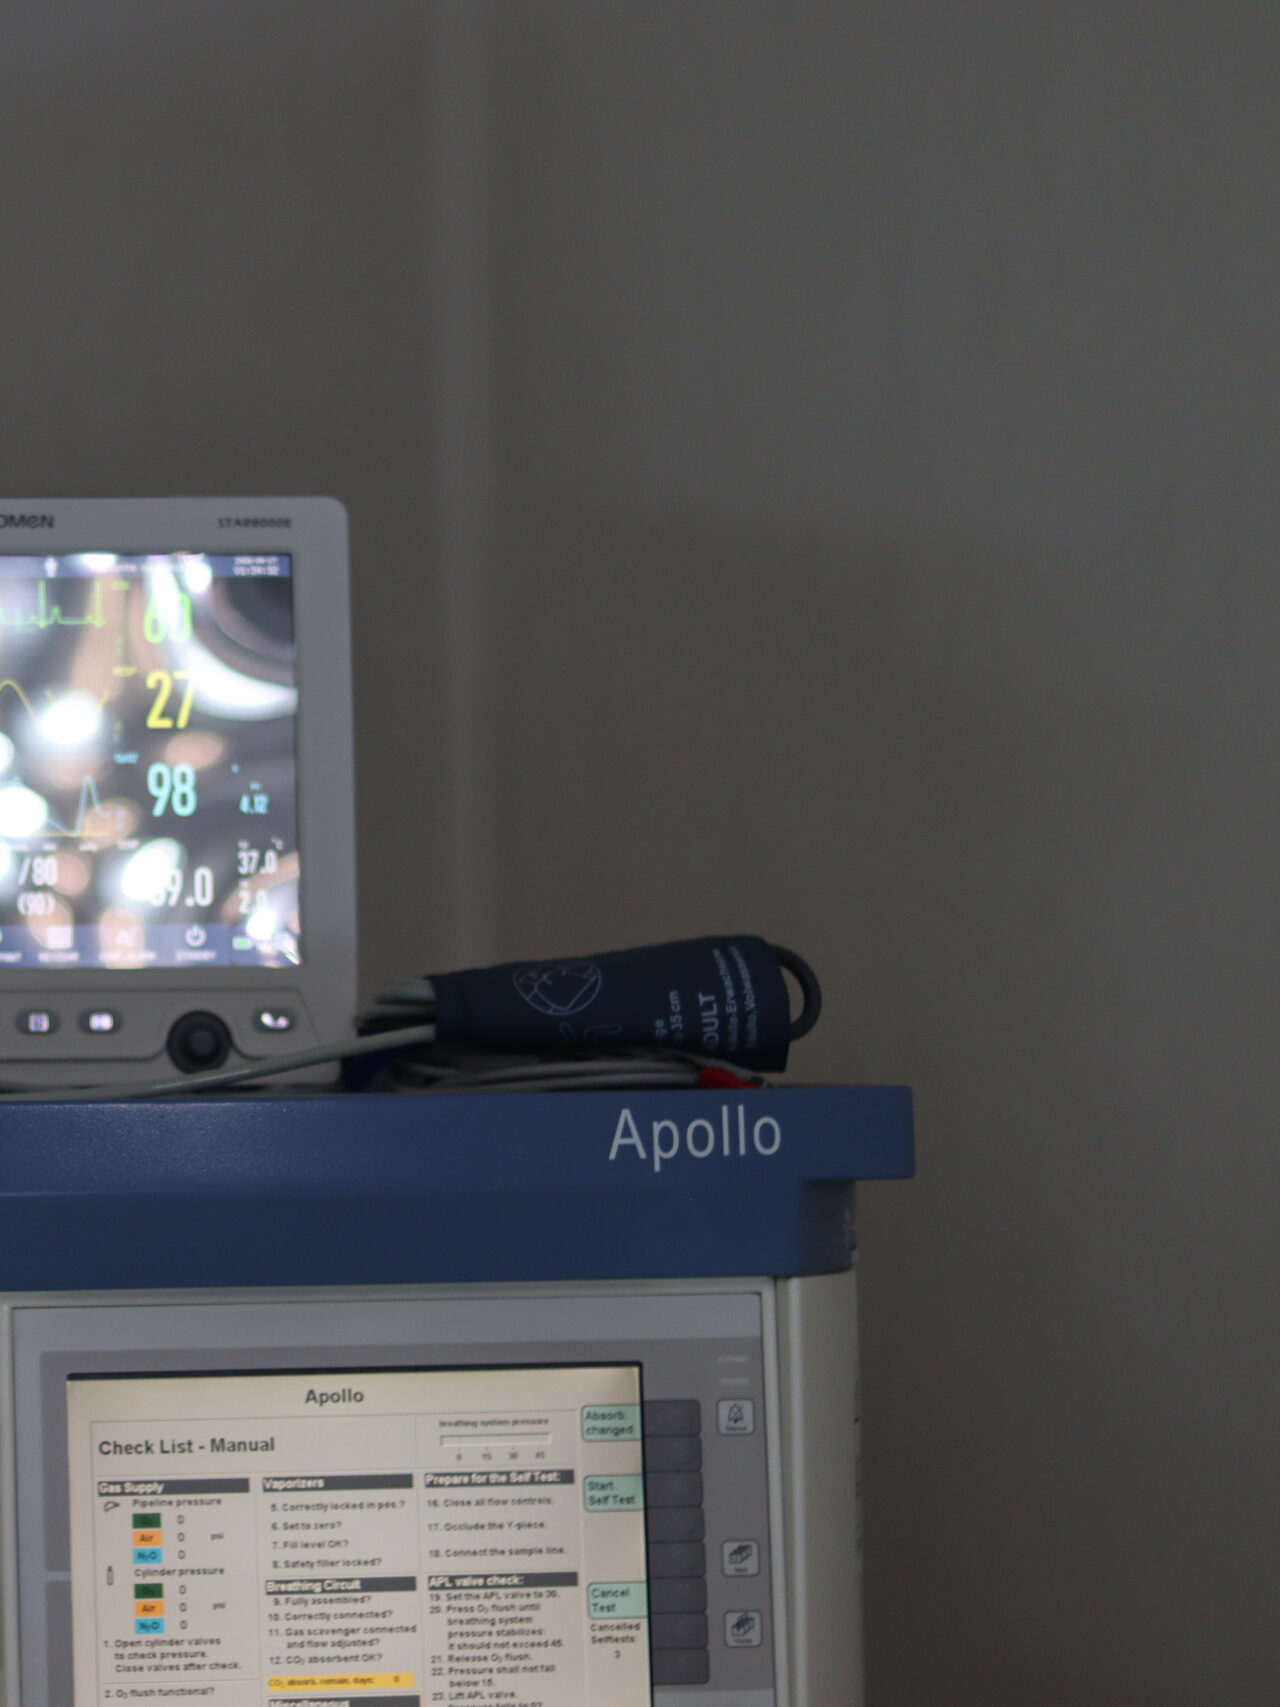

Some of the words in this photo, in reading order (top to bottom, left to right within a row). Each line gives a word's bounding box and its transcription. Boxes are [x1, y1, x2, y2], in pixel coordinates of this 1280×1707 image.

[146, 670, 194, 729] 27
[147, 762, 197, 817] 98
[238, 851, 277, 874] 37.0
[17, 891, 56, 915] (90)
[669, 991, 681, 1013] cm
[670, 1014, 683, 1032] 35
[699, 992, 720, 1047] DULT
[609, 1104, 782, 1172] Apollo
[304, 1388, 364, 1407] Apollo
[585, 1410, 625, 1420] Absorb.
[439, 1420, 477, 1428] breathing
[480, 1419, 509, 1427] system
[512, 1418, 548, 1426] pressure
[586, 1425, 633, 1435] changed
[98, 1440, 155, 1455] Check
[160, 1438, 194, 1454] List
[210, 1437, 275, 1452] Manual
[425, 1474, 469, 1486] Prepare
[471, 1473, 487, 1484] for
[489, 1473, 507, 1483] the
[509, 1472, 531, 1483] Self
[533, 1471, 561, 1482] Test:
[98, 1483, 120, 1493] Gas
[123, 1482, 164, 1494] Supply
[264, 1479, 325, 1490] Vaporizers
[588, 1481, 614, 1491] Start
[133, 1499, 173, 1507] Pipeline
[176, 1498, 222, 1507] pressure
[444, 1499, 471, 1507] Close
[487, 1498, 508, 1506] flow
[588, 1496, 609, 1506] Self
[613, 1495, 635, 1504] Test
[282, 1503, 328, 1512] Correctly
[330, 1501, 364, 1510] locked
[444, 1522, 485, 1531] Occlude
[140, 1534, 154, 1542] Air
[283, 1541, 298, 1549] Fill
[446, 1549, 487, 1557] Connect
[508, 1548, 543, 1557] sample
[284, 1560, 314, 1570] Safety
[342, 1558, 382, 1567] locked?
[134, 1569, 176, 1579] Cylinder
[179, 1568, 224, 1577] pressure
[266, 1581, 322, 1593] Breathing
[324, 1580, 360, 1591] Circuit
[429, 1577, 453, 1587] APL
[455, 1576, 484, 1586] valve
[504, 1591, 531, 1599] valve
[591, 1588, 629, 1598] Cancel
[285, 1597, 308, 1607] Fully
[311, 1595, 371, 1605] assembled?
[142, 1604, 156, 1612] Air
[446, 1605, 474, 1613] Press
[491, 1604, 516, 1612] flush
[519, 1603, 540, 1611] until
[593, 1603, 616, 1613] Test
[285, 1612, 331, 1622] Correctly
[333, 1610, 392, 1620] connected?
[448, 1617, 495, 1626] breathing
[498, 1616, 533, 1625] system
[307, 1627, 360, 1637] scavenger
[363, 1625, 417, 1634] connected
[591, 1623, 640, 1631] Cancelled
[448, 1630, 492, 1640] pressure
[114, 1639, 142, 1649] Open
[145, 1638, 185, 1648] cylinder
[188, 1637, 221, 1645] valves
[306, 1640, 328, 1648] flow
[330, 1638, 380, 1649] adjusted?
[457, 1641, 491, 1649] should
[512, 1640, 549, 1648] exceed
[128, 1651, 156, 1659] check
[160, 1651, 208, 1661] pressure.
[308, 1654, 359, 1663] absorbent
[115, 1664, 143, 1672] Close
[147, 1663, 180, 1672] valves
[184, 1662, 206, 1670] after
[209, 1662, 241, 1670] check.
[448, 1667, 493, 1675] Pressure
[538, 1664, 555, 1672] fall
[449, 1679, 479, 1688] below
[130, 1689, 156, 1697] flush
[158, 1687, 215, 1697] functional?
